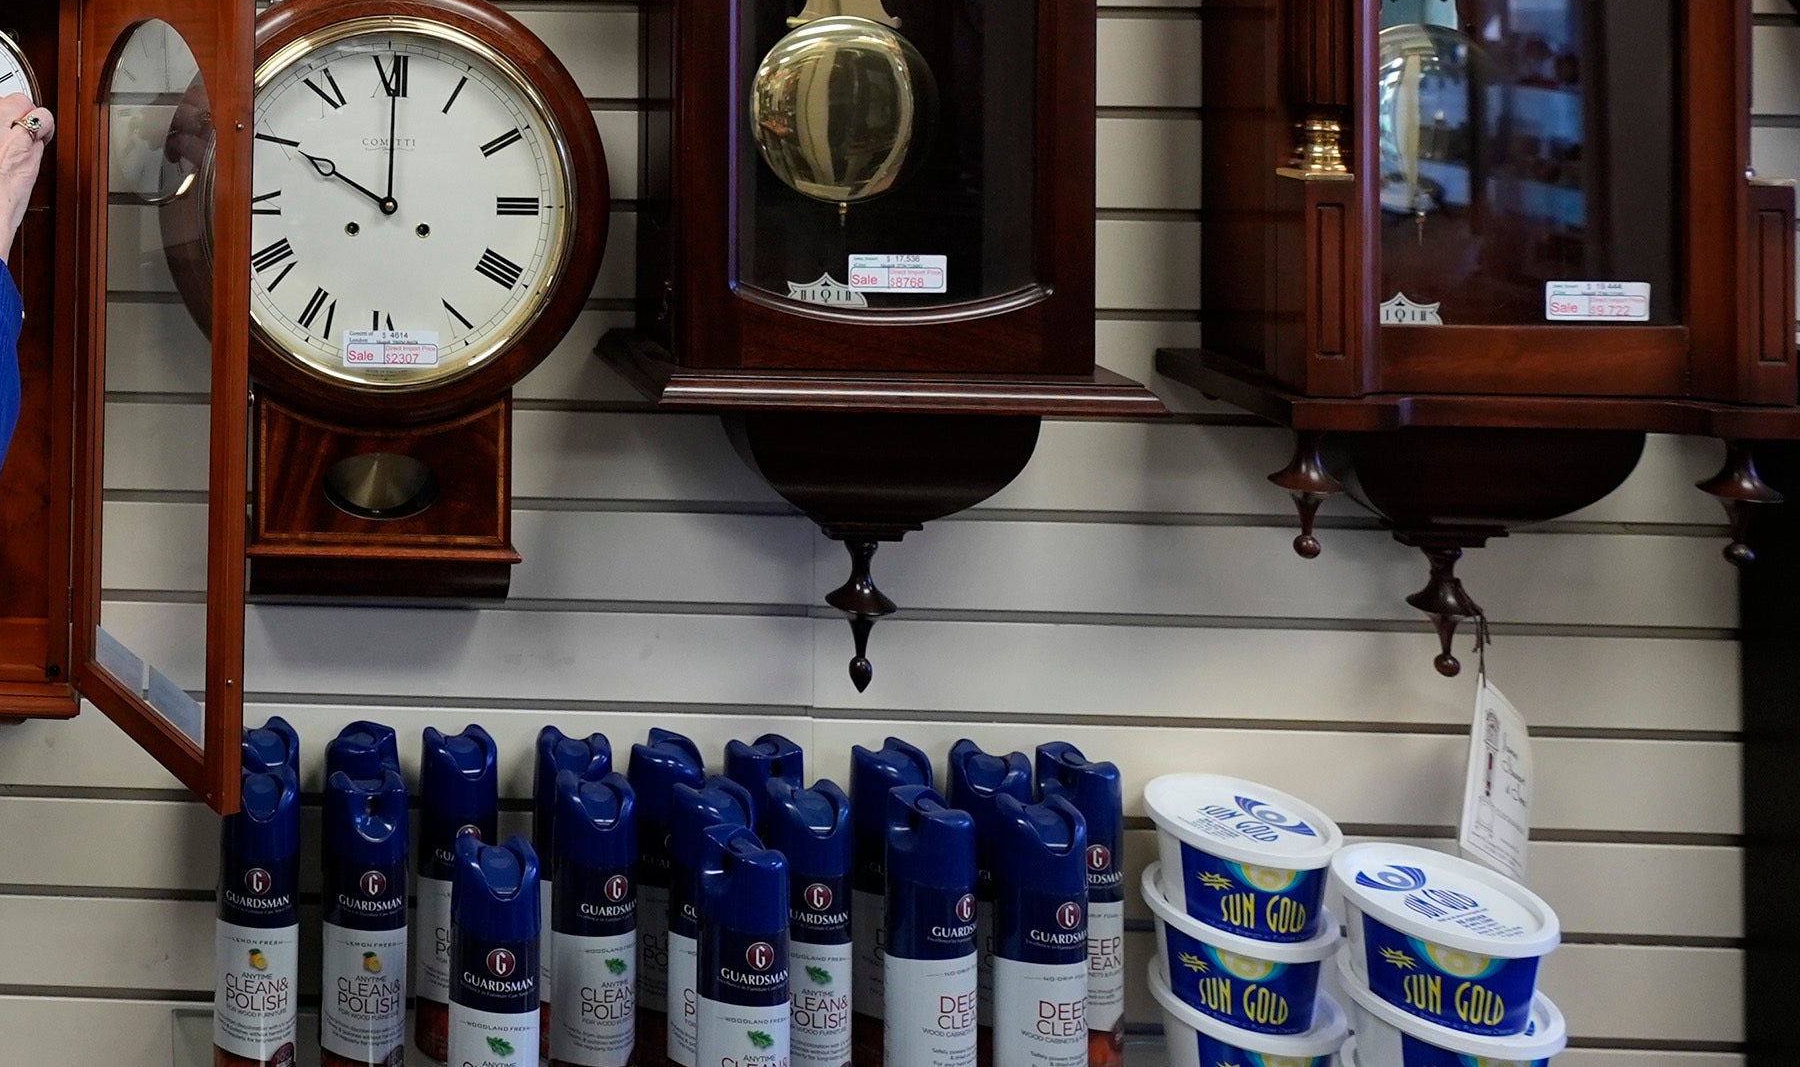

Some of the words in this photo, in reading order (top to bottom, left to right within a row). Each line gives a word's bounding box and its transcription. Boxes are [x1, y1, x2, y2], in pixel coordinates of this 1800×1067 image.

[302, 66, 348, 119] XI
[442, 75, 468, 114] I
[255, 119, 300, 161] X
[362, 137, 416, 147] COMTTI
[480, 127, 523, 158] II
[497, 197, 539, 216] III
[474, 247, 523, 290] IIII
[852, 275, 877, 285] Sale
[890, 278, 924, 288] $8768
[298, 285, 337, 341] VII
[1551, 302, 1577, 313] Sale
[442, 297, 474, 339] V
[349, 350, 374, 360] Sale
[386, 354, 419, 364] $2307
[1200, 805, 1240, 820] SUN
[1236, 821, 1279, 842] GOLD
[226, 890, 289, 909] GUARDSMAN
[338, 894, 402, 912] GUARDSMAN
[1404, 893, 1448, 919] SUN
[1421, 888, 1479, 911] GOLD
[790, 909, 849, 925] UARDSMAN
[1221, 892, 1255, 929] SUN
[1266, 895, 1306, 933] GOLD
[241, 972, 273, 980] ANYTIME
[464, 971, 534, 992] GUARDSMAN
[601, 979, 629, 988] ANYTIME
[721, 968, 789, 986] GUARDSMAN
[226, 987, 288, 1012] POLISH
[801, 988, 834, 996] ANYTIME
[1199, 977, 1232, 1015] SUN
[1243, 984, 1288, 1025] GOLD
[1403, 974, 1442, 1015] SUN
[1455, 982, 1505, 1026] GOLD
[338, 991, 400, 1014] POLISH
[466, 1021, 508, 1031] WOODLAND
[922, 1027, 945, 1037] WOOD
[1021, 1029, 1045, 1042] WOOD
[743, 1054, 776, 1062] ANYTIME
